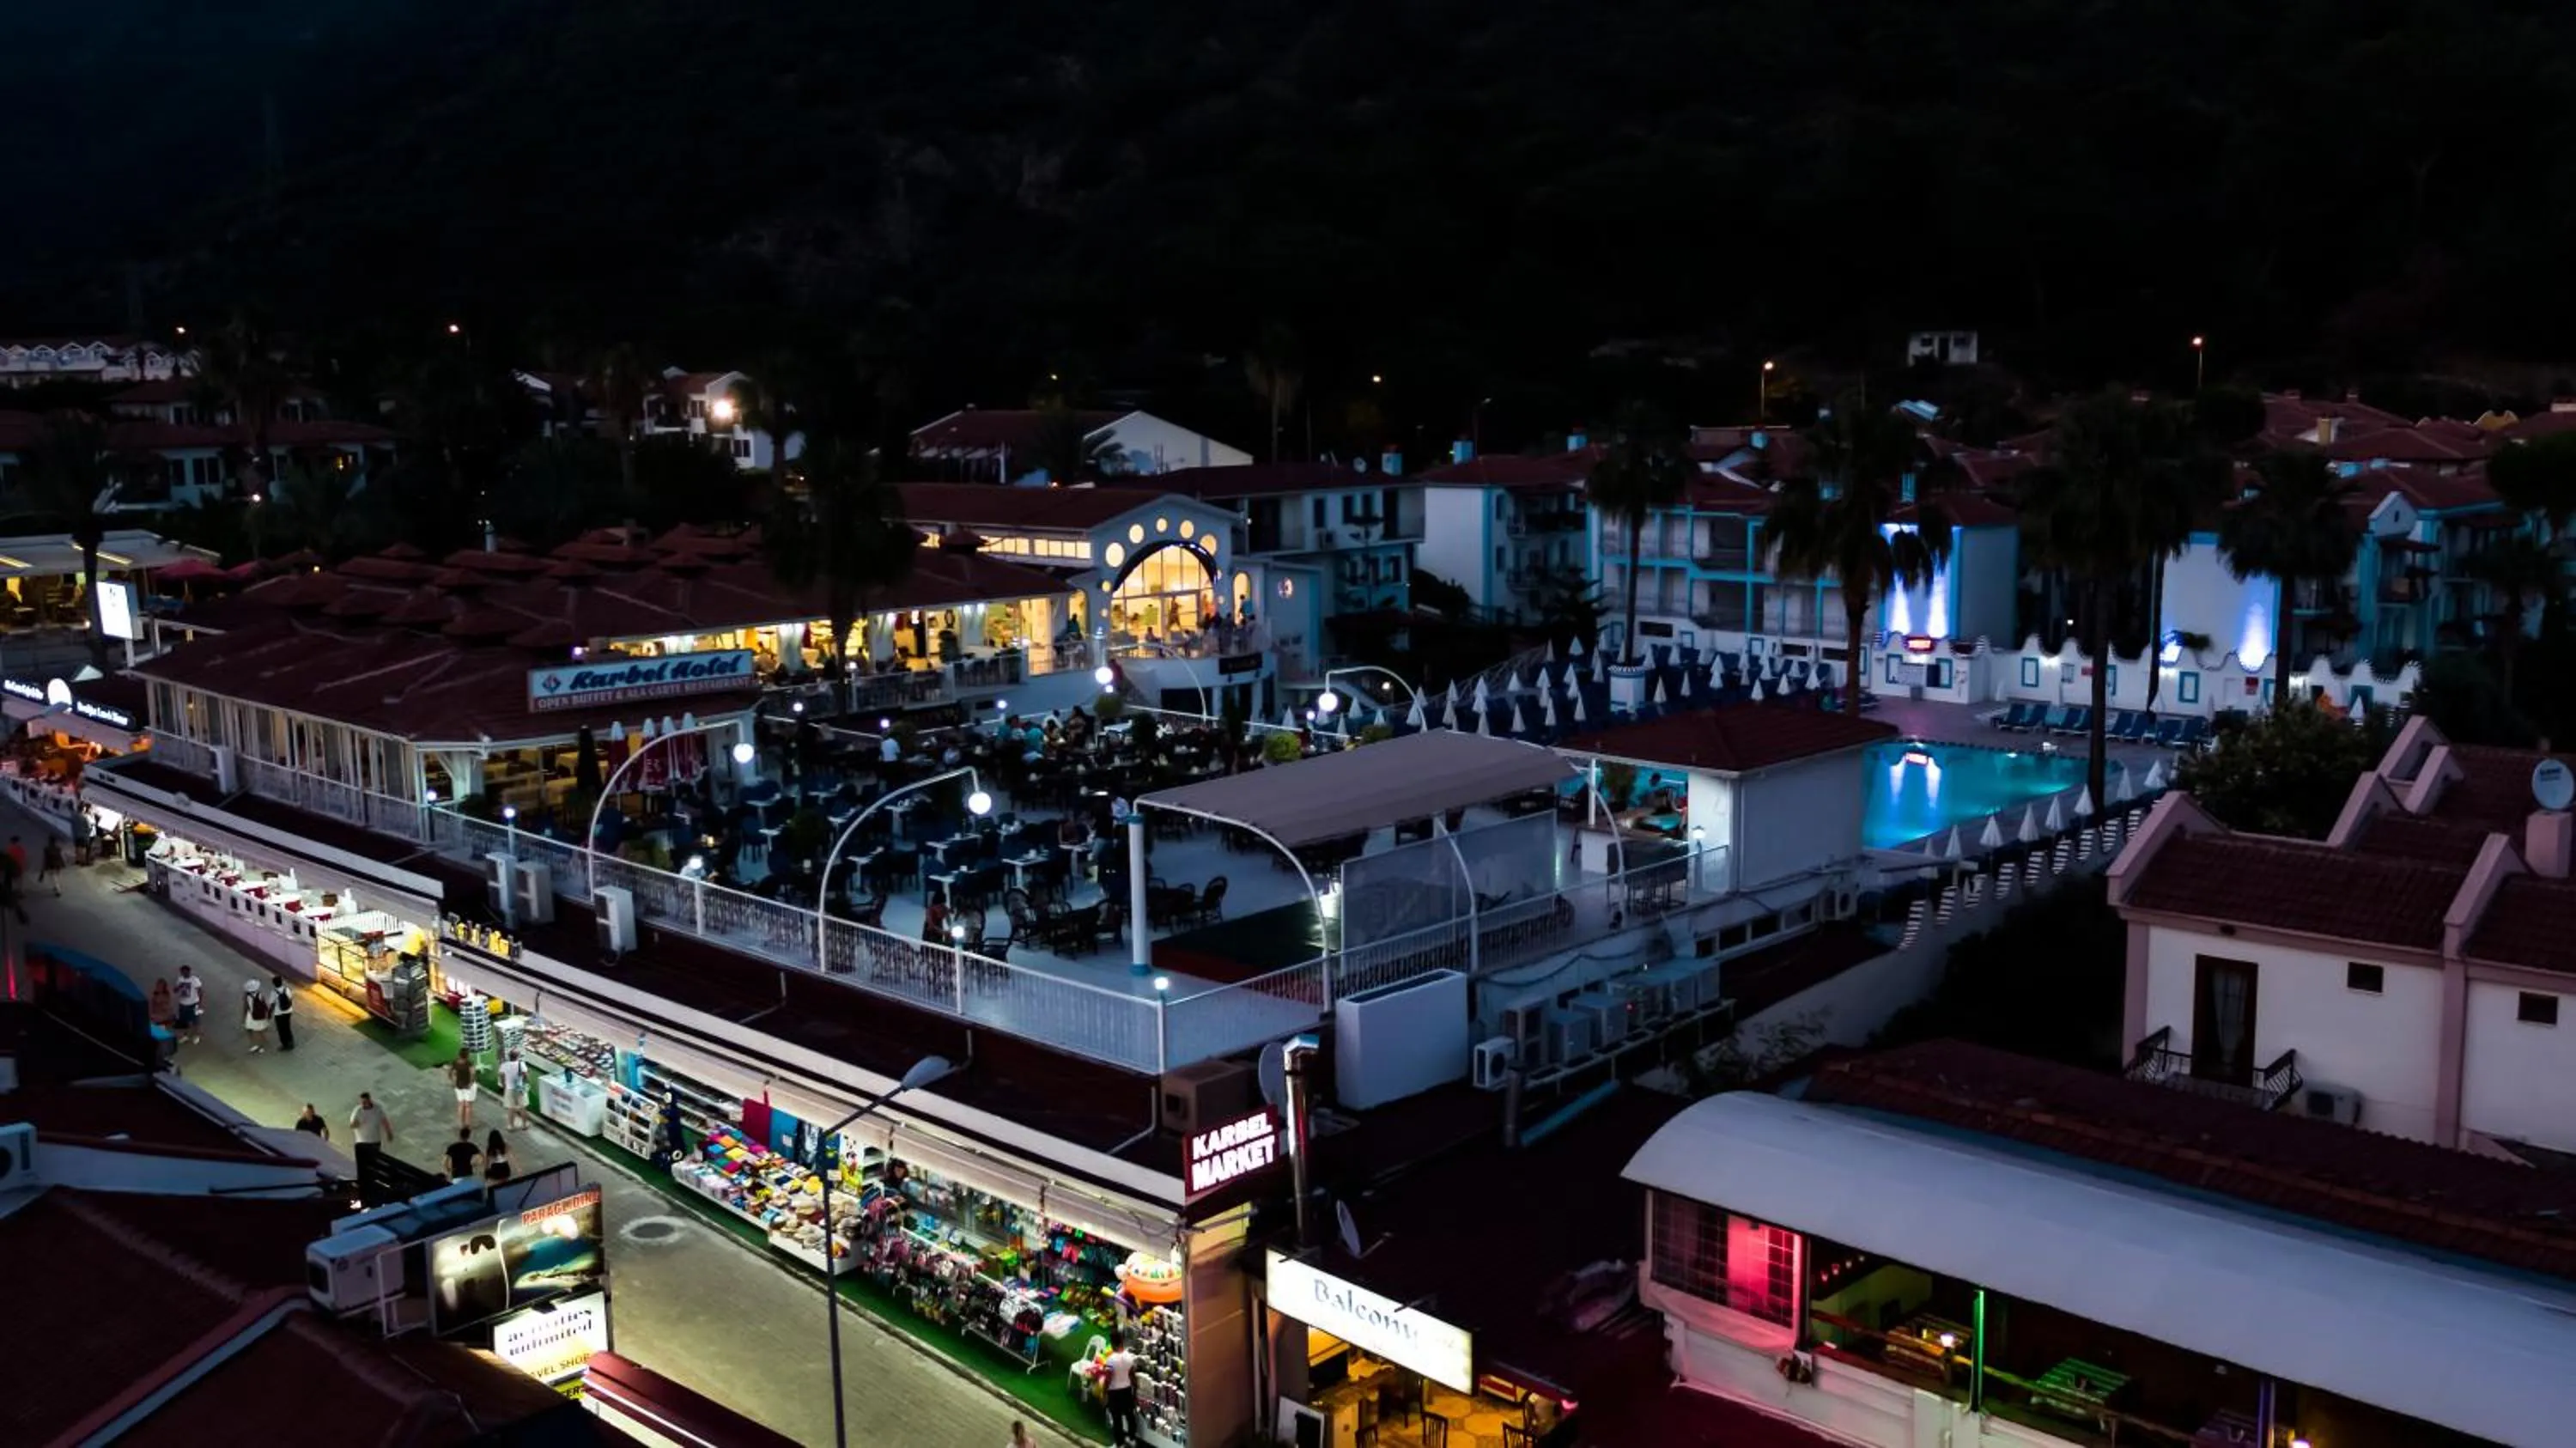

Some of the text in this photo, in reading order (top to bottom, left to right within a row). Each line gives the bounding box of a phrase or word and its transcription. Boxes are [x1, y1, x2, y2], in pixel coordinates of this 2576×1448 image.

[569, 654, 743, 690] Karbel Hotel
[538, 696, 568, 709] OPEN
[572, 689, 612, 704] BUFFET
[1192, 1112, 1273, 1160] KARBEL
[1192, 1135, 1275, 1191] MARKET
